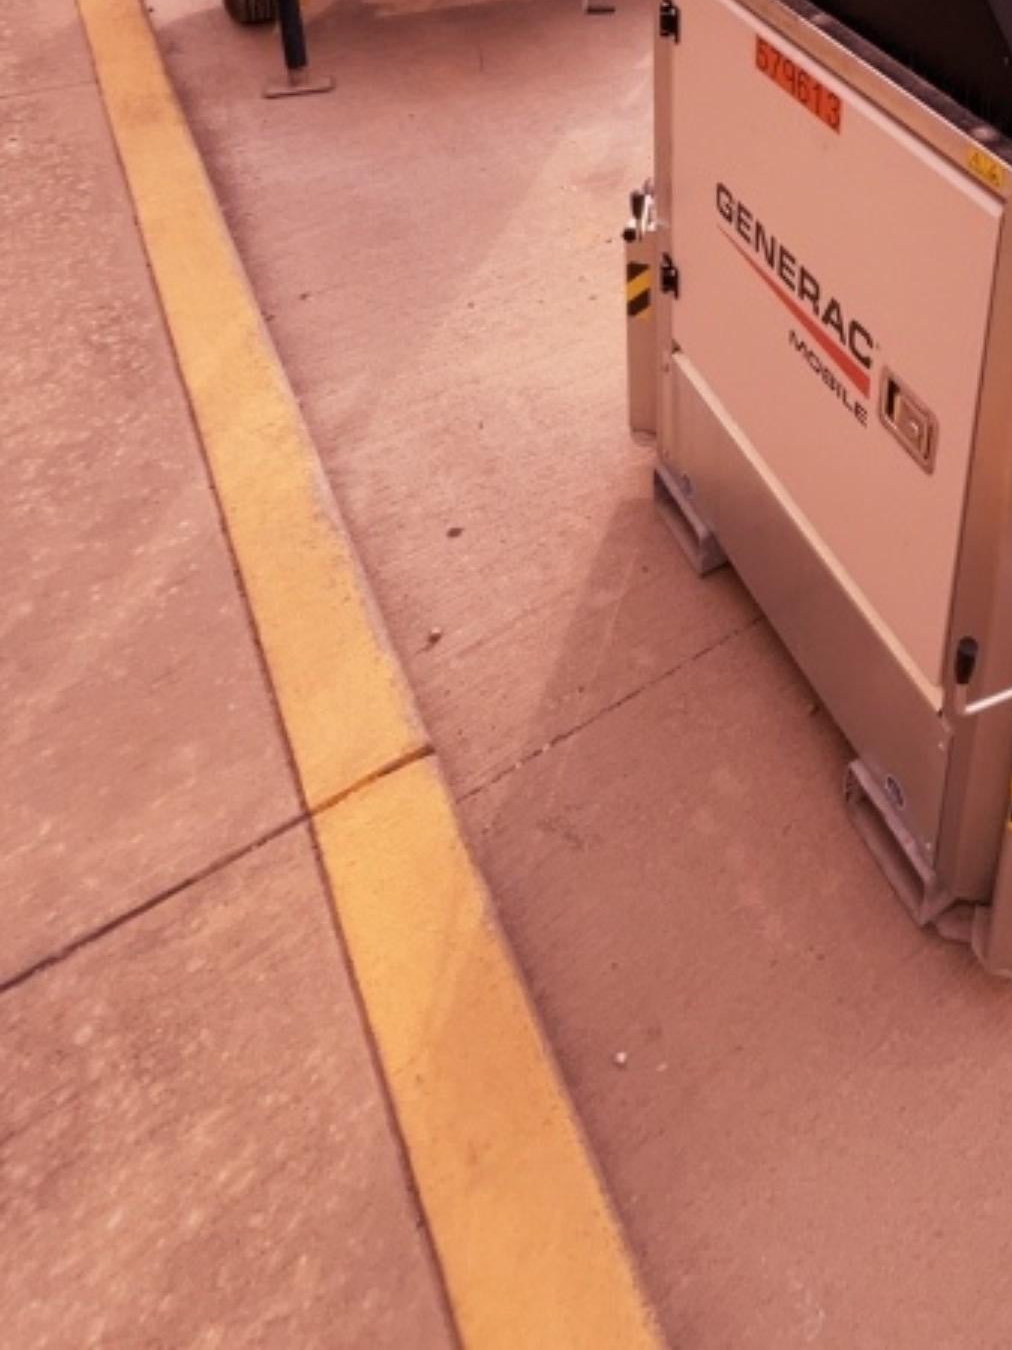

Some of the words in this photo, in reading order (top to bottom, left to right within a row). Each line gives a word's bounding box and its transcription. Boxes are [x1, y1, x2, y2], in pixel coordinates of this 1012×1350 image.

[756, 36, 841, 134] 579613
[716, 182, 873, 369] GENERAC
[788, 329, 869, 429] MOBILE
